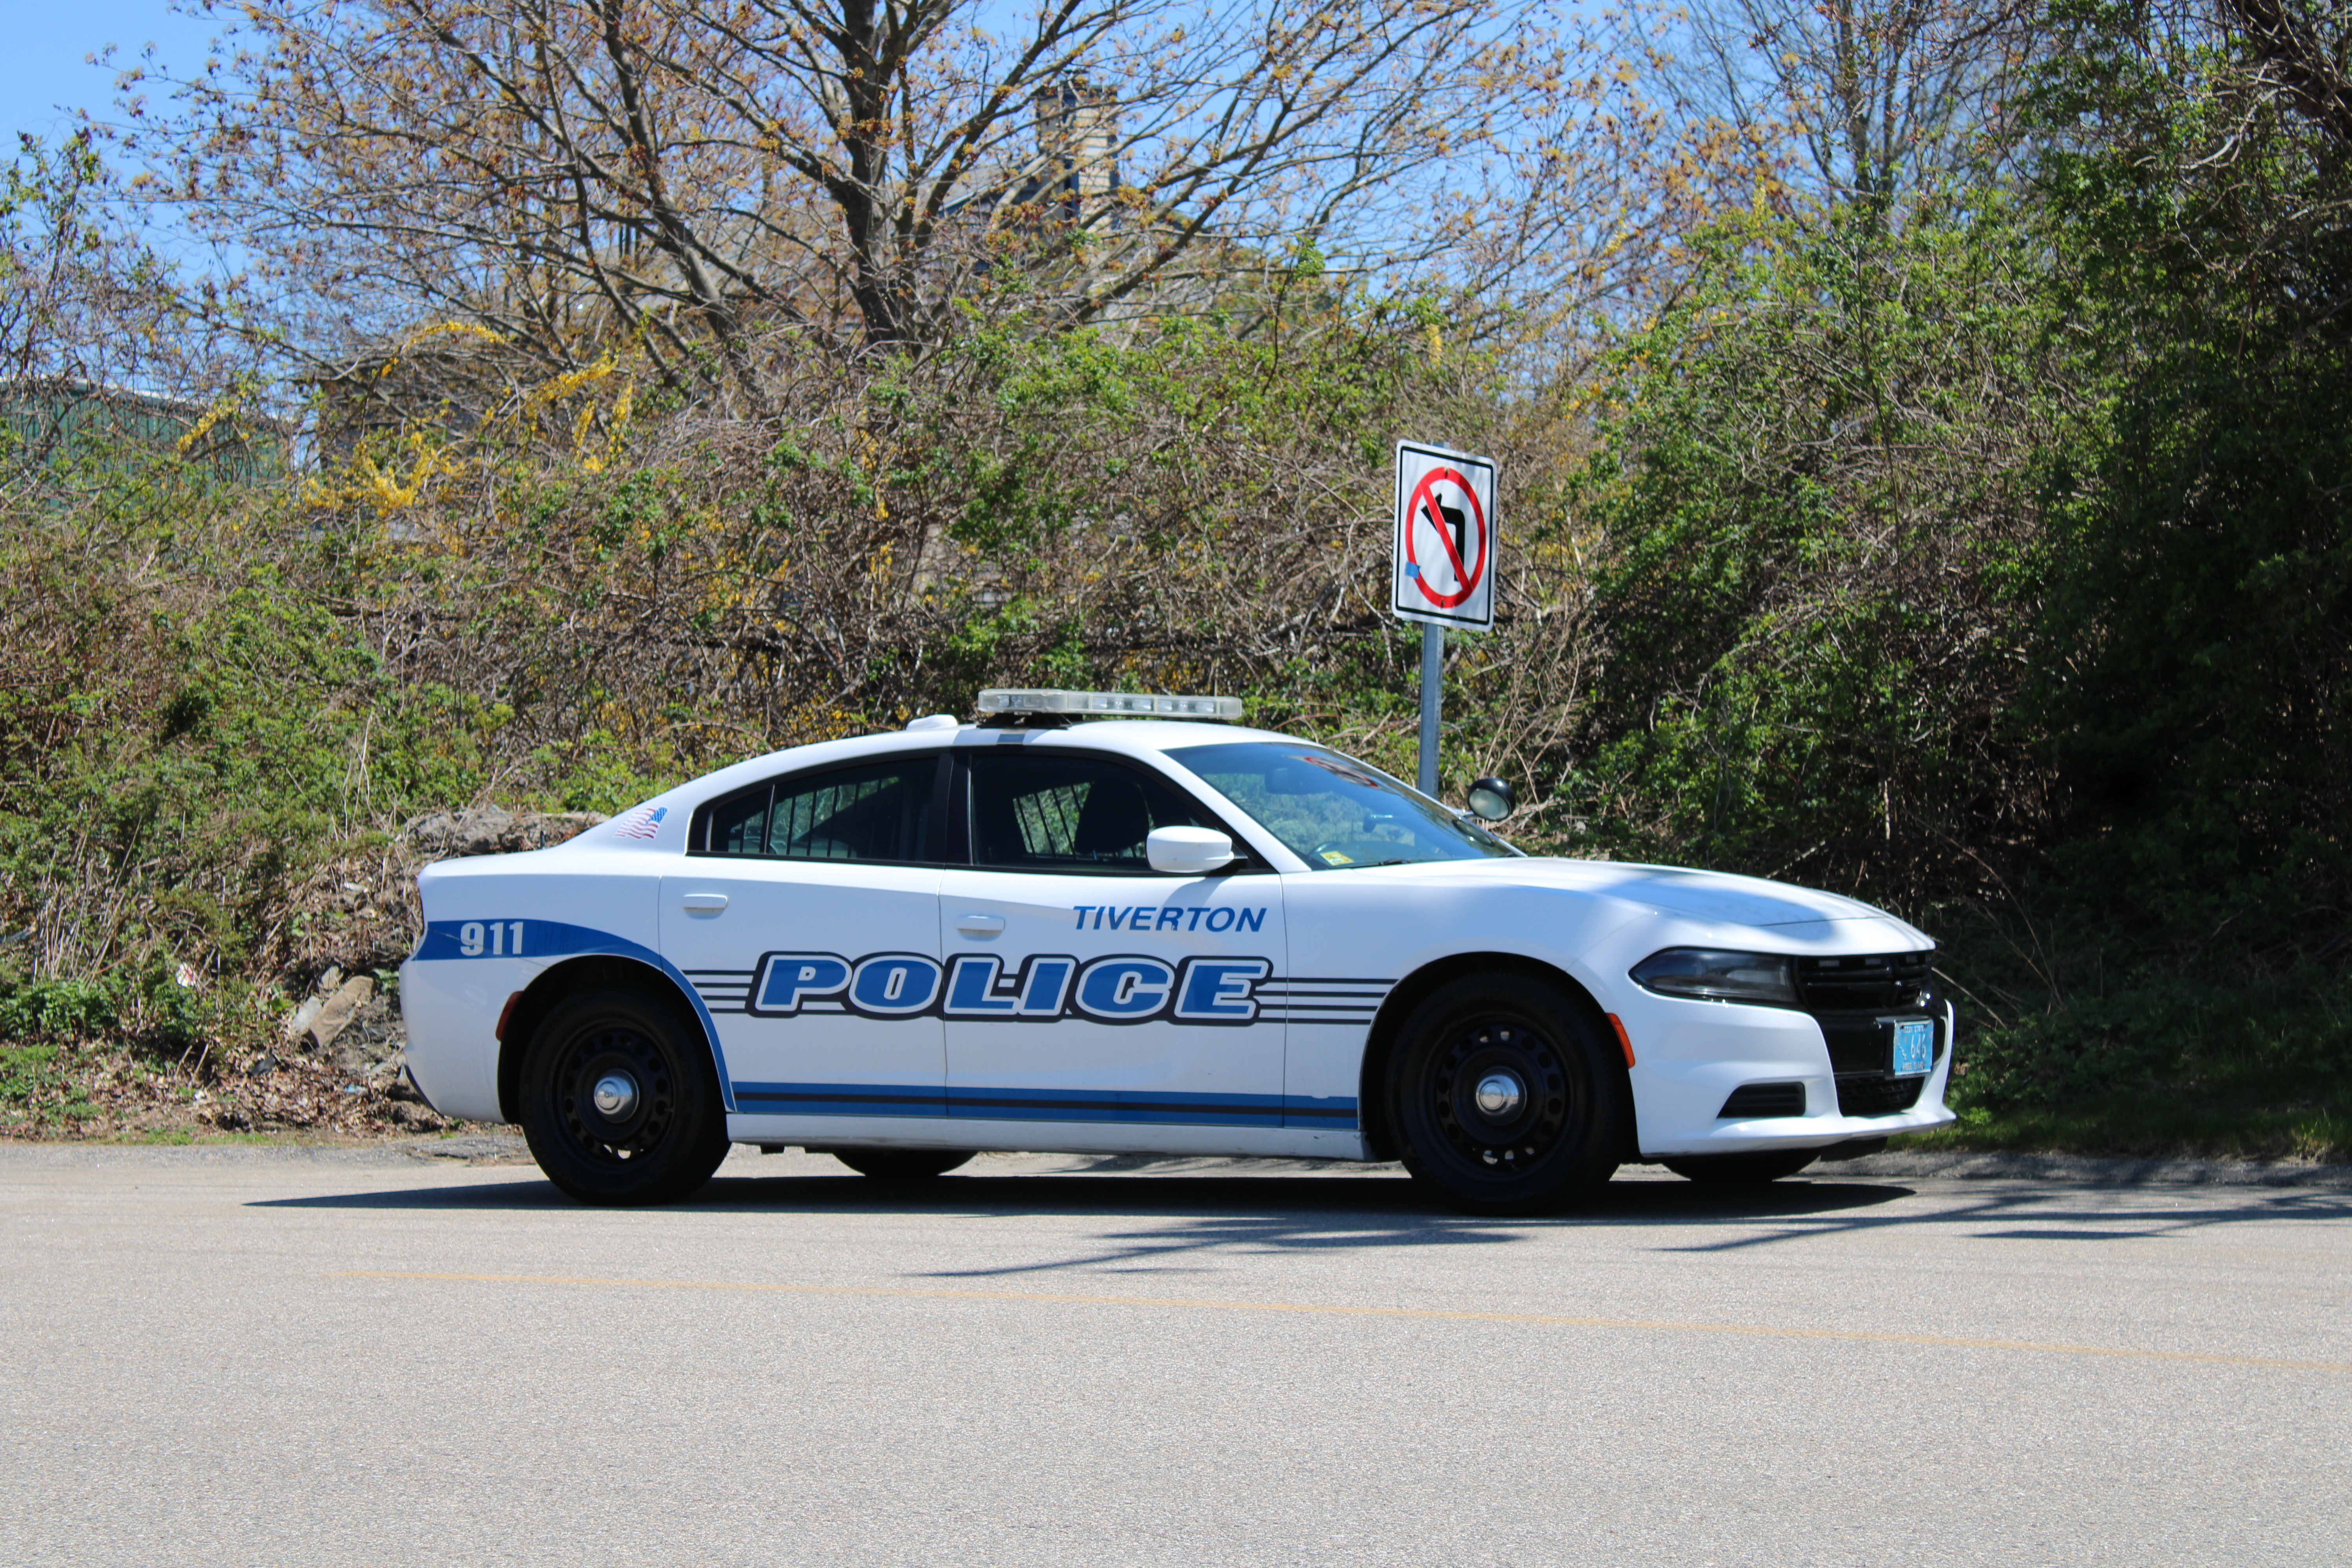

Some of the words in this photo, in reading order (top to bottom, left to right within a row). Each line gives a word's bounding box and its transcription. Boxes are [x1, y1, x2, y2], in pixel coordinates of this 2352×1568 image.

[1073, 906, 1267, 932] TIVERTON
[460, 922, 524, 956] 911
[749, 951, 1271, 1026] POLICE
[1910, 1034, 1926, 1059] 646
